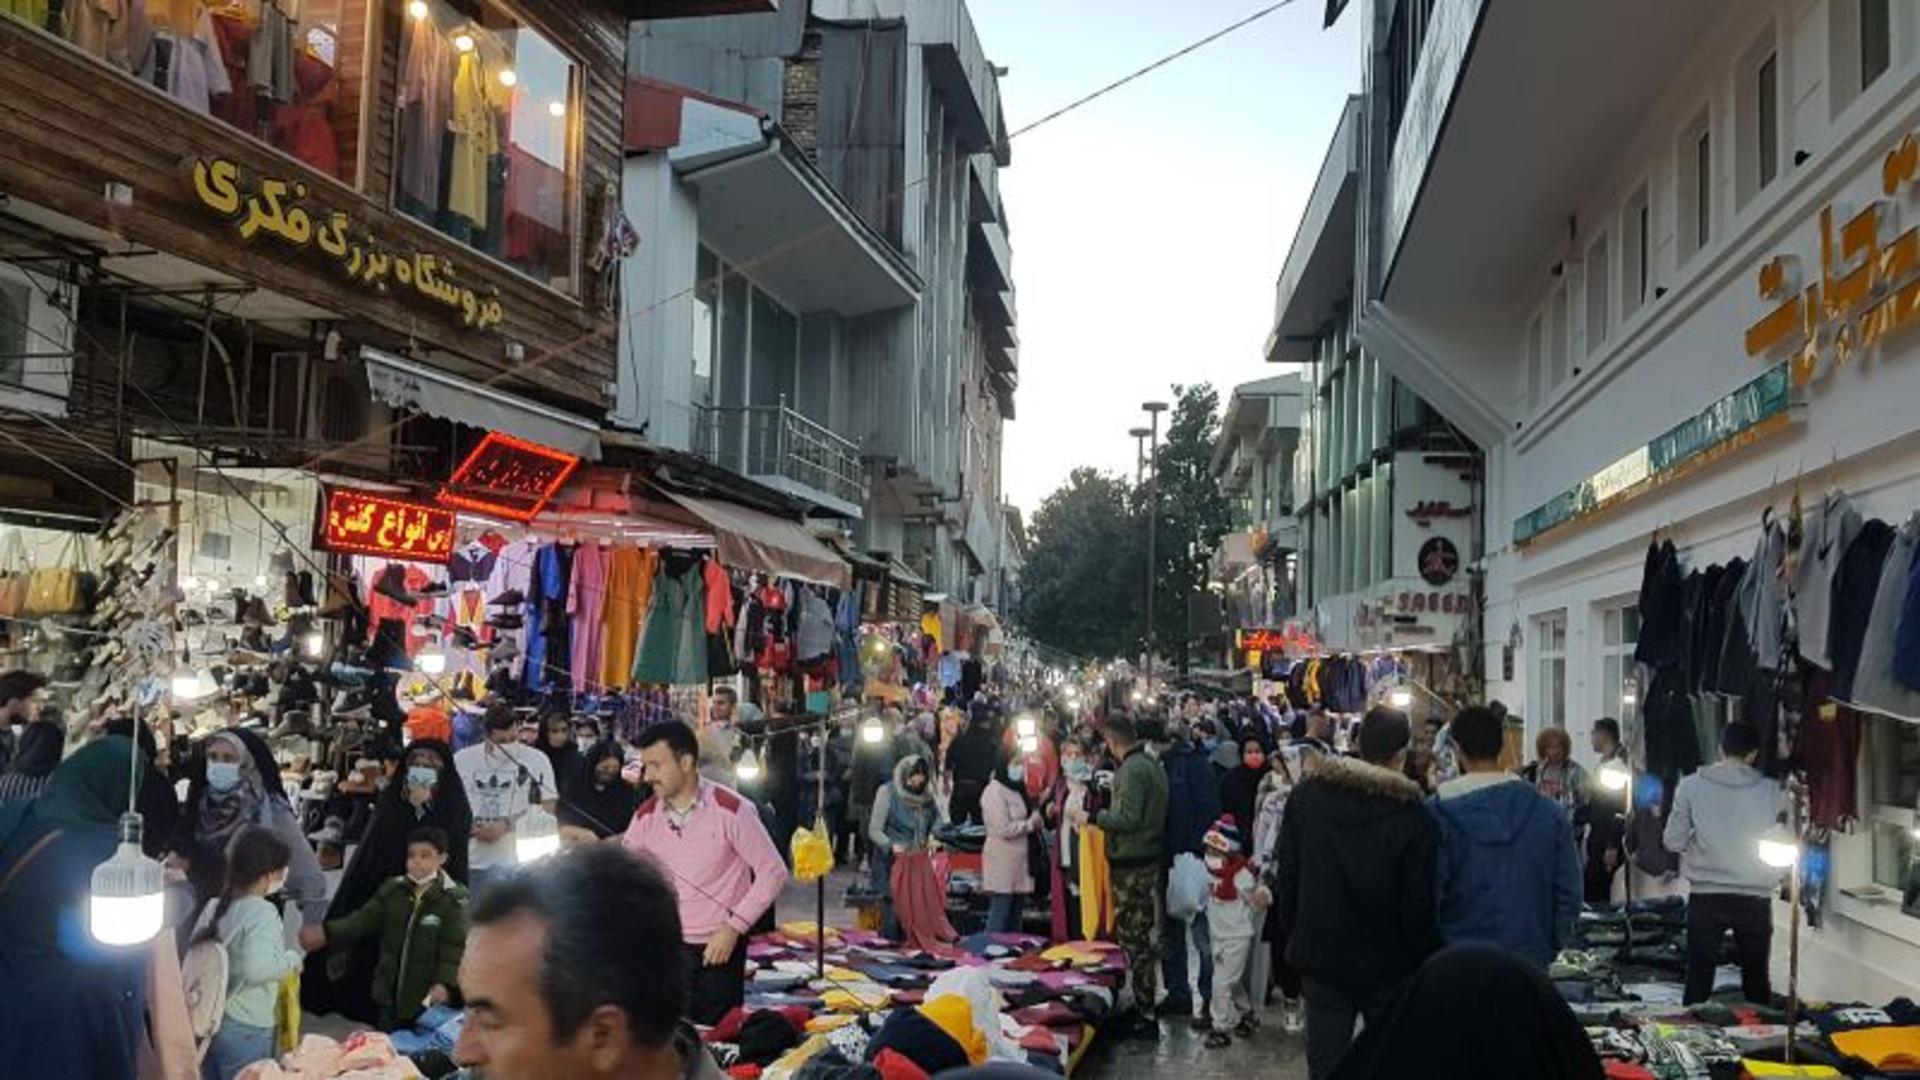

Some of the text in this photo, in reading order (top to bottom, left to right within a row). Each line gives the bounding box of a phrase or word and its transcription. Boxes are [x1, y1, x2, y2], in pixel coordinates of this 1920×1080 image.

[193, 158, 502, 329] فروشگاه بزرگ فکری
[377, 508, 429, 551] انواع
